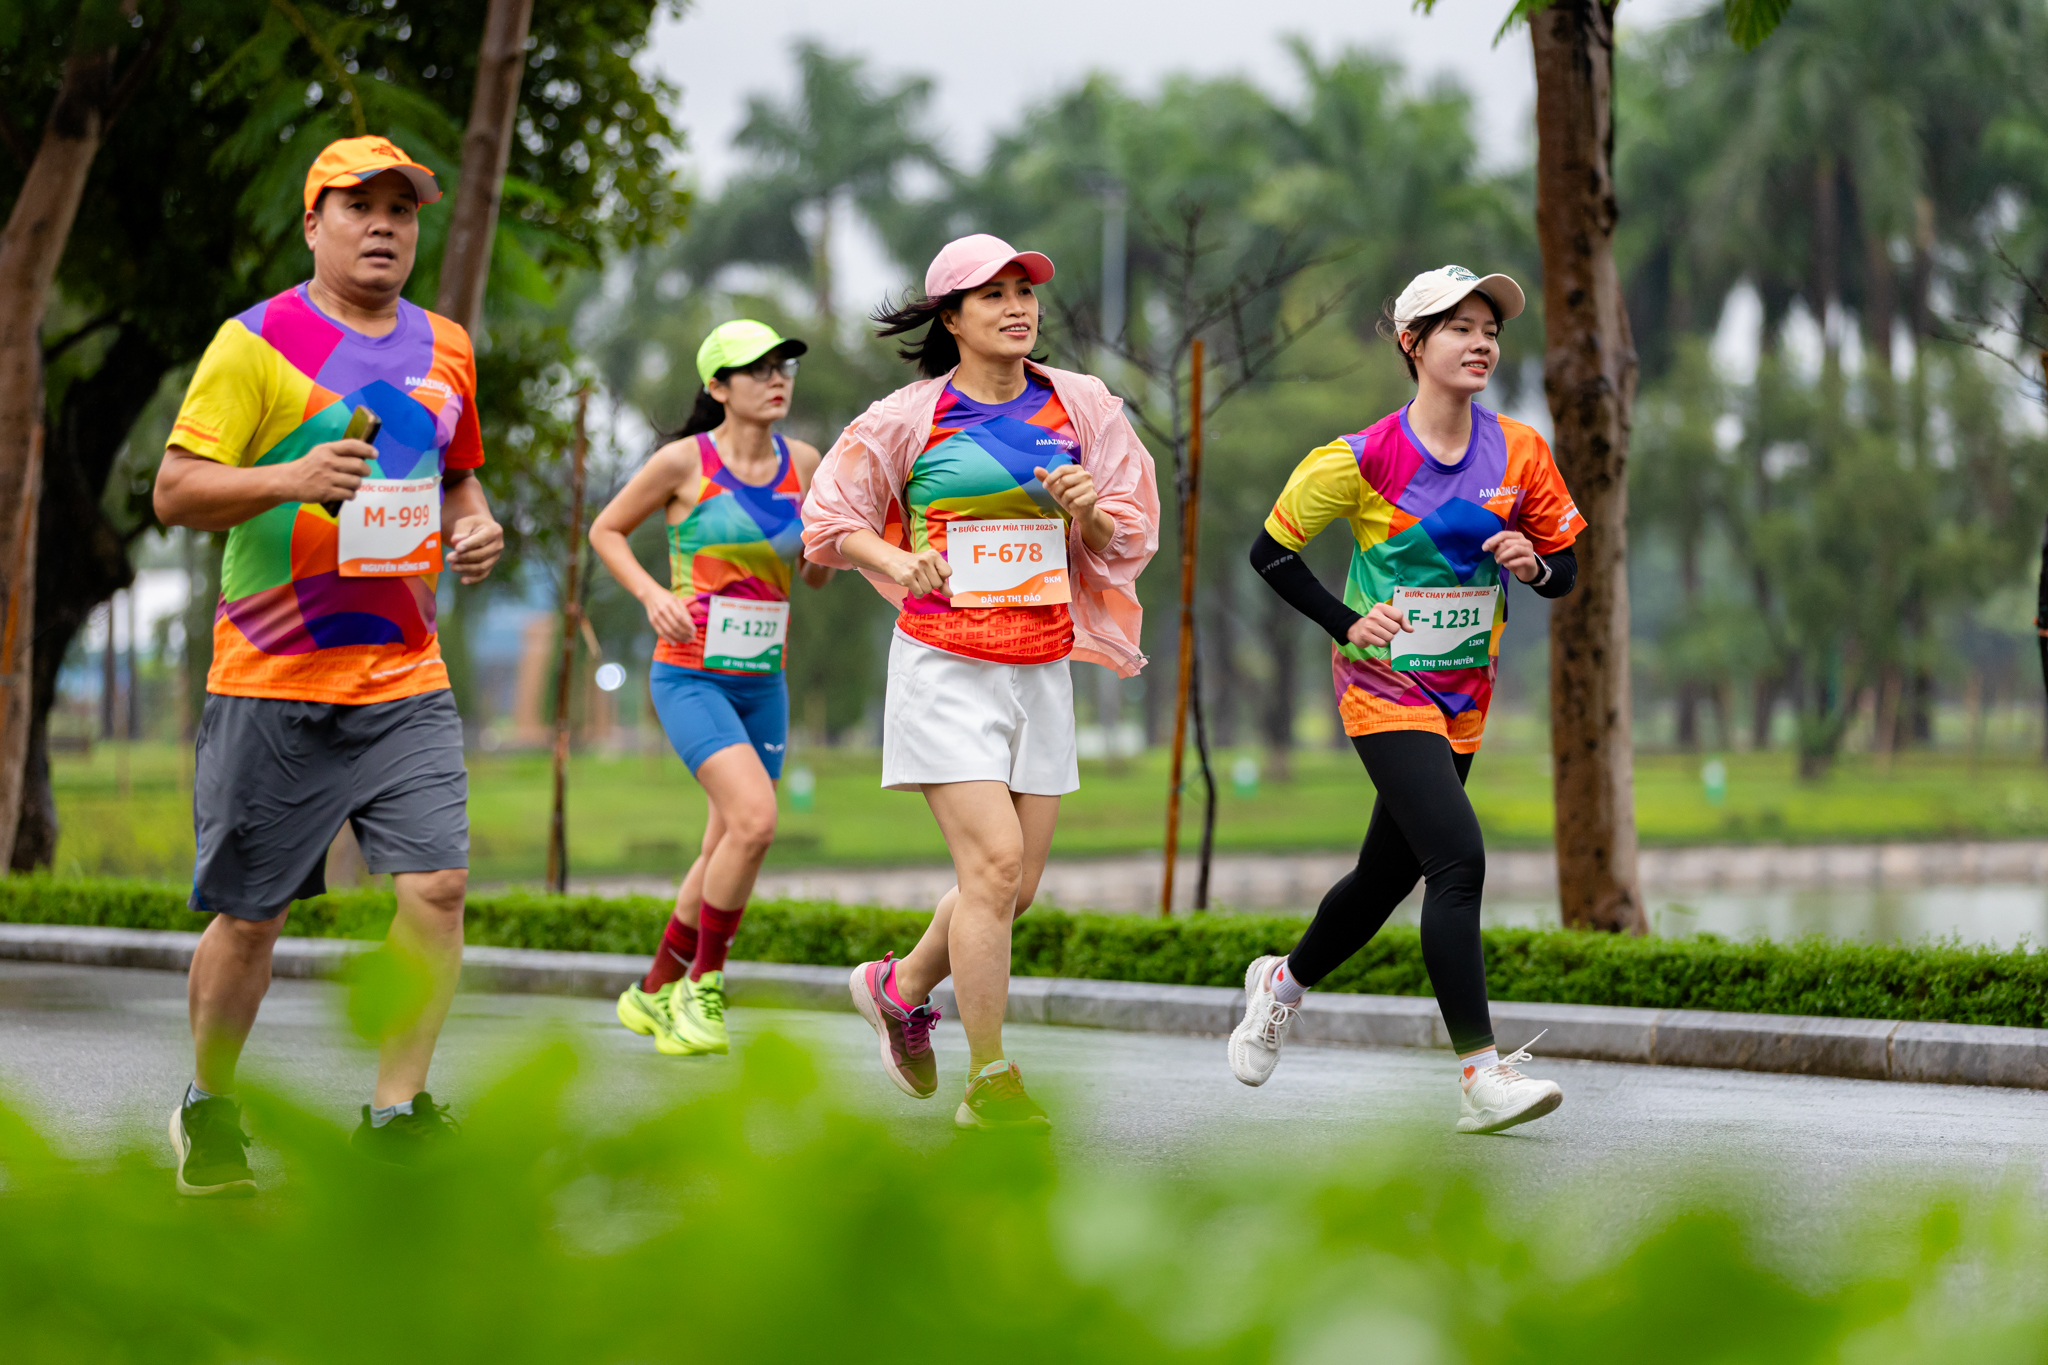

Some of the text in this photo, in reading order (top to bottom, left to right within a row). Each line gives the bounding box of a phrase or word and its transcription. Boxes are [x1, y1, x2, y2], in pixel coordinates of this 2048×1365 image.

[363, 504, 430, 528] M-999
[958, 524, 979, 533] BƯỚC
[980, 525, 1001, 533] CHẠY
[1002, 523, 1019, 532] MÙA
[972, 543, 1043, 564] F-678
[1043, 575, 1062, 583] 8KM
[981, 592, 1041, 605] ĐẶNG THỊ ĐÀO
[1404, 590, 1425, 598] BƯỚC
[1425, 591, 1445, 600] CHẠY
[1446, 591, 1461, 599] MÙA
[1408, 607, 1480, 629] F-1231
[721, 617, 778, 638] F-1227
[966, 631, 984, 639] BE
[987, 626, 1019, 638] LAST
[986, 638, 1019, 650] LAST
[1421, 659, 1436, 668] THỊ
